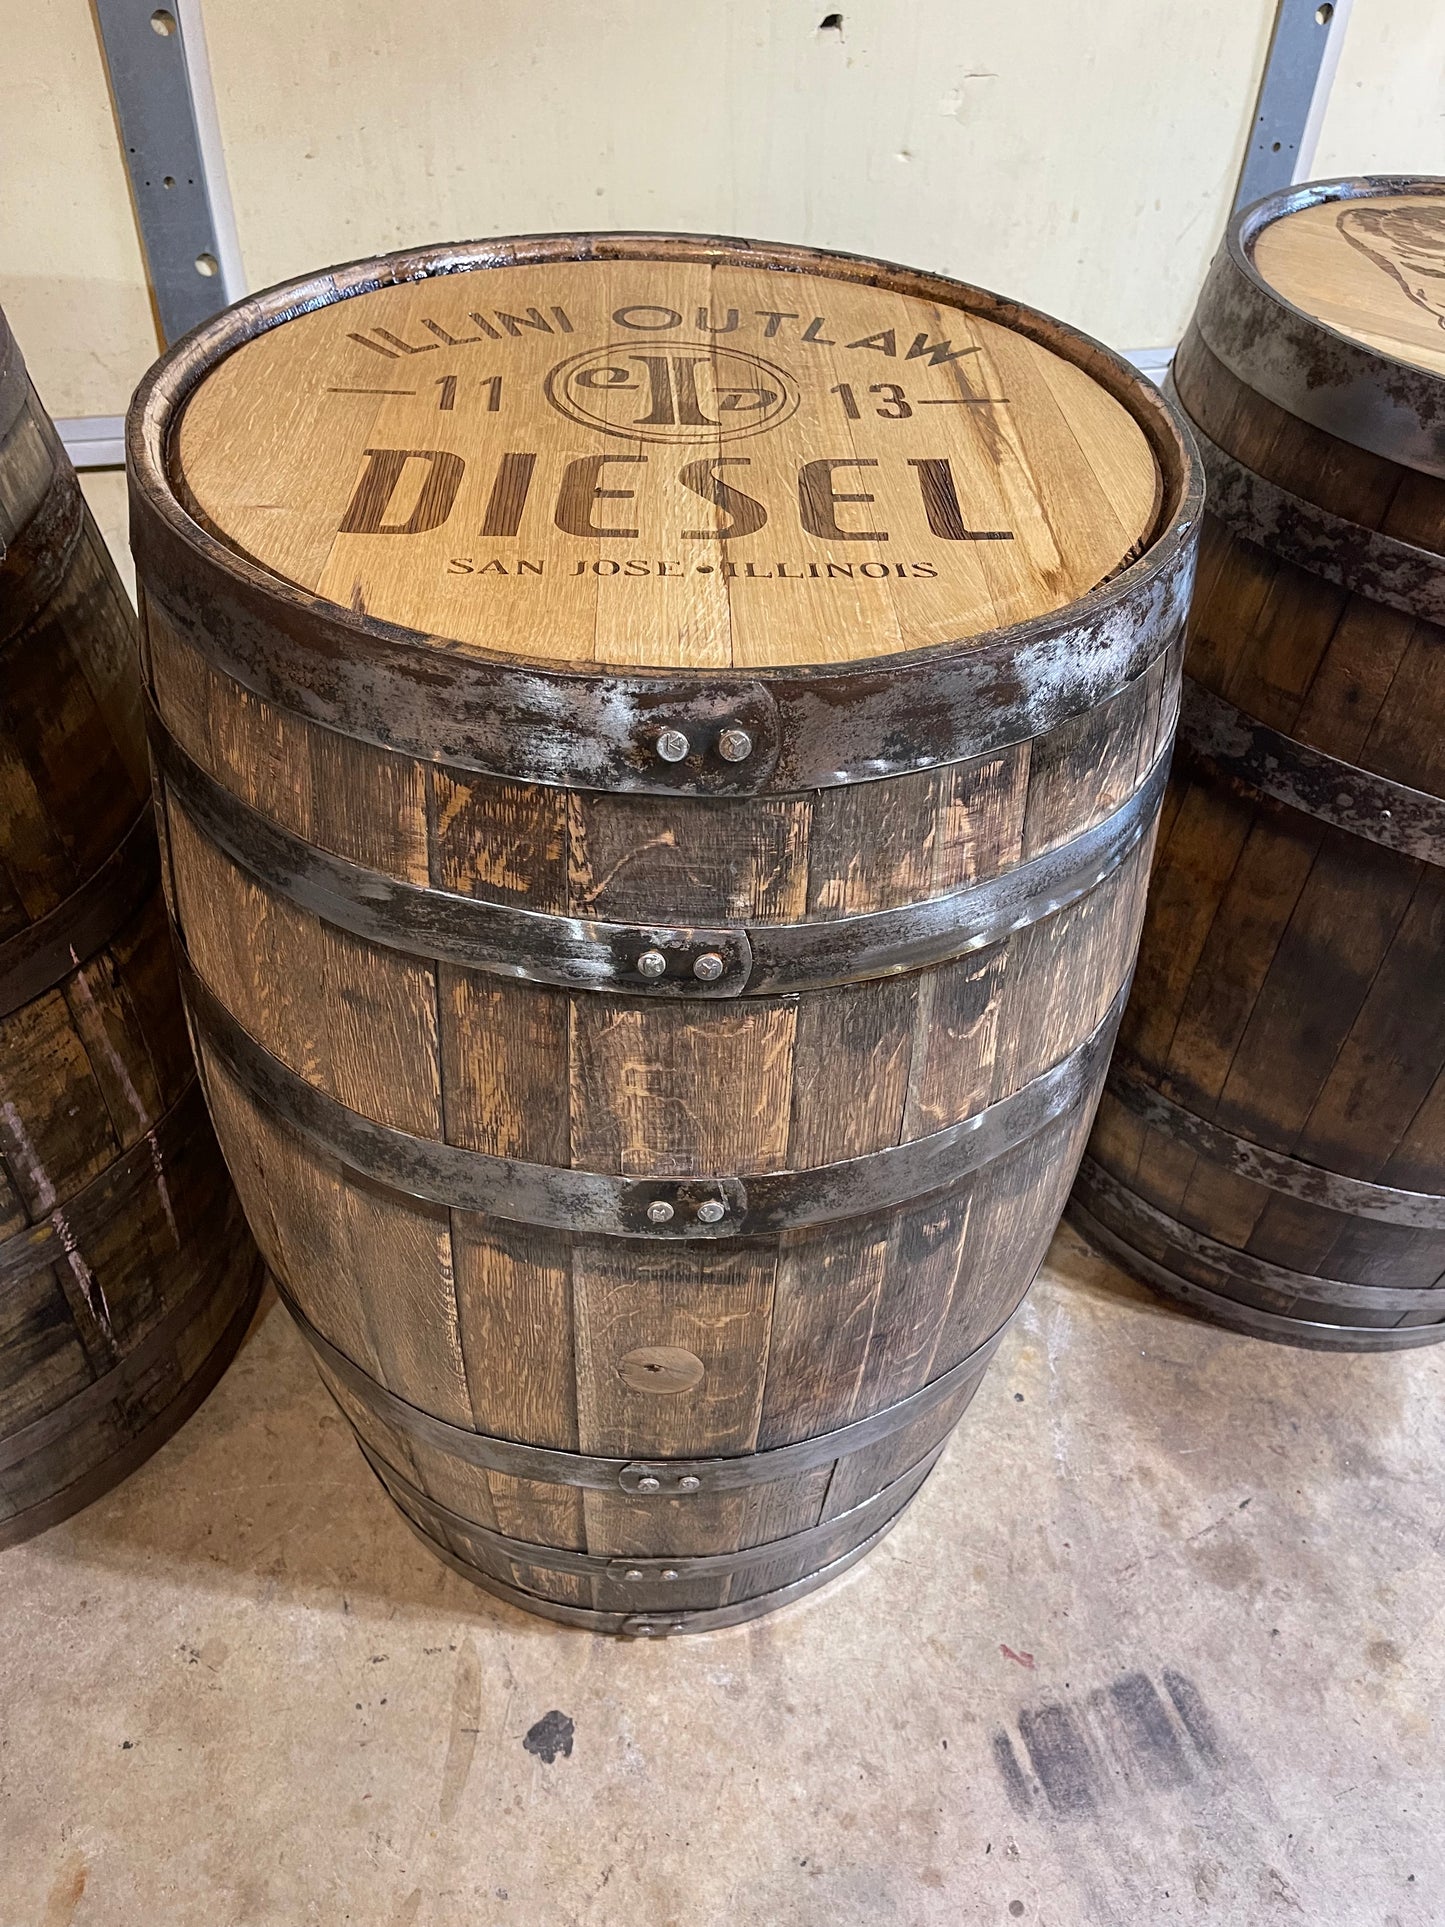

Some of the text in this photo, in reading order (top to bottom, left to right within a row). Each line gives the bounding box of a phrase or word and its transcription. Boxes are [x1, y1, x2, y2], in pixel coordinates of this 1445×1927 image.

[346, 305, 982, 366] ILLINI OUTLAW
[434, 375, 502, 411] 11
[830, 383, 913, 419] 13
[337, 448, 1015, 541] DIESEL
[446, 557, 939, 580] SAN JOSE ILLINOIS
